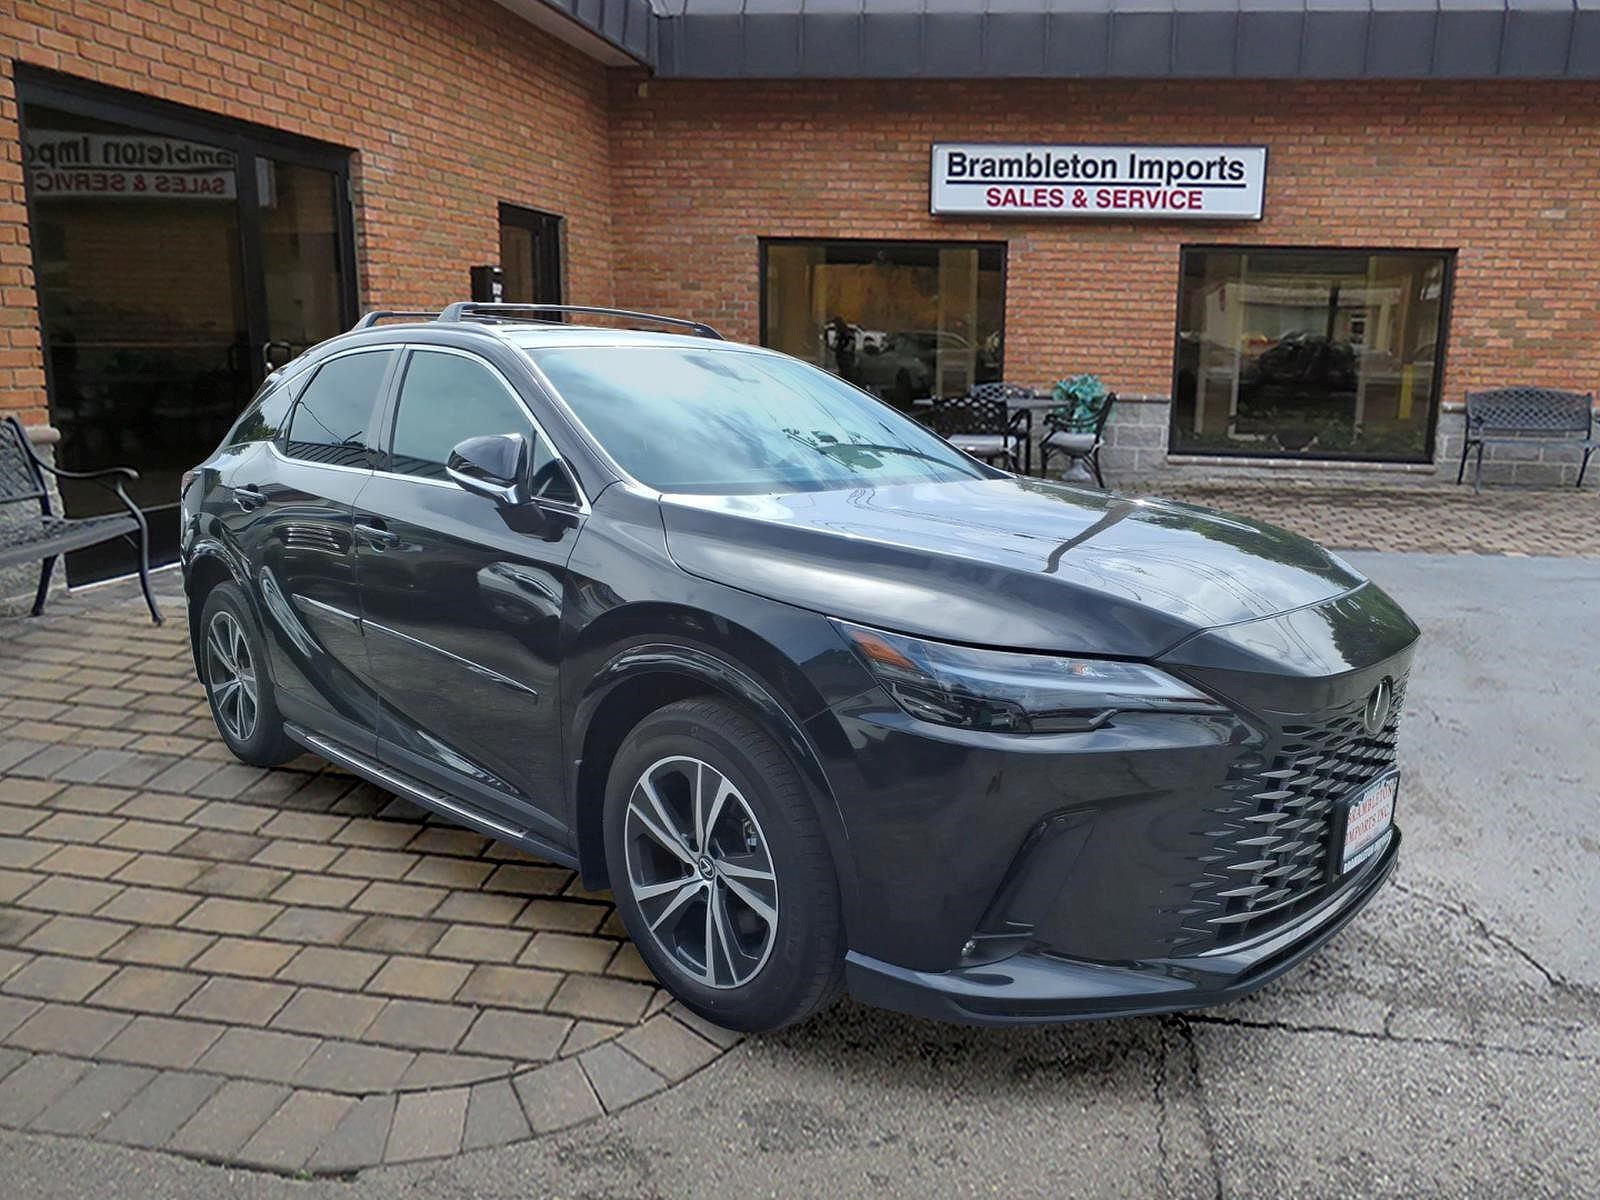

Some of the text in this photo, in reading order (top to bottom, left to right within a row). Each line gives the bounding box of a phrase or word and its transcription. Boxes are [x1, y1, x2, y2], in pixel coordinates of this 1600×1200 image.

[948, 152, 1246, 186] Brambleton Imports
[986, 187, 1203, 209] SALES & SERVICE
